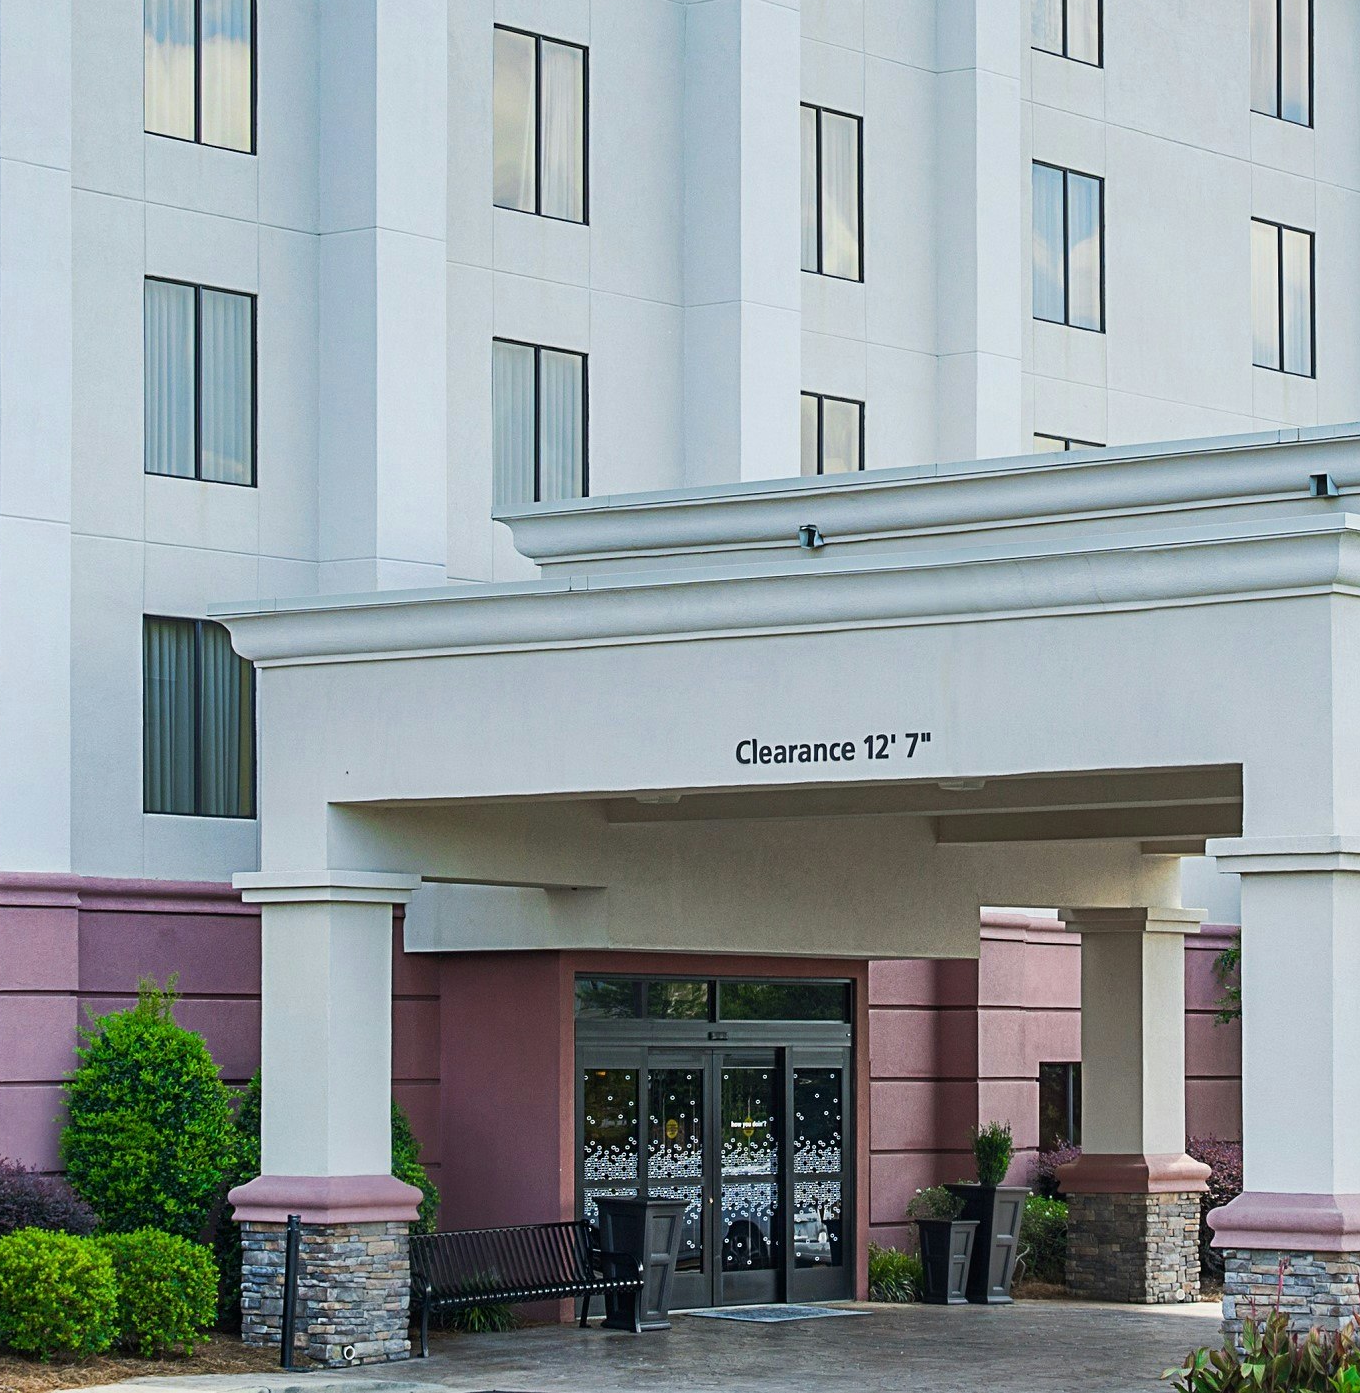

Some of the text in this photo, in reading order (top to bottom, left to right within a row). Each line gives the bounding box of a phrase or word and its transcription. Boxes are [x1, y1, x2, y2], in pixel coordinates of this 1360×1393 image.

[735, 732, 932, 764] Clearance 12' 7"
